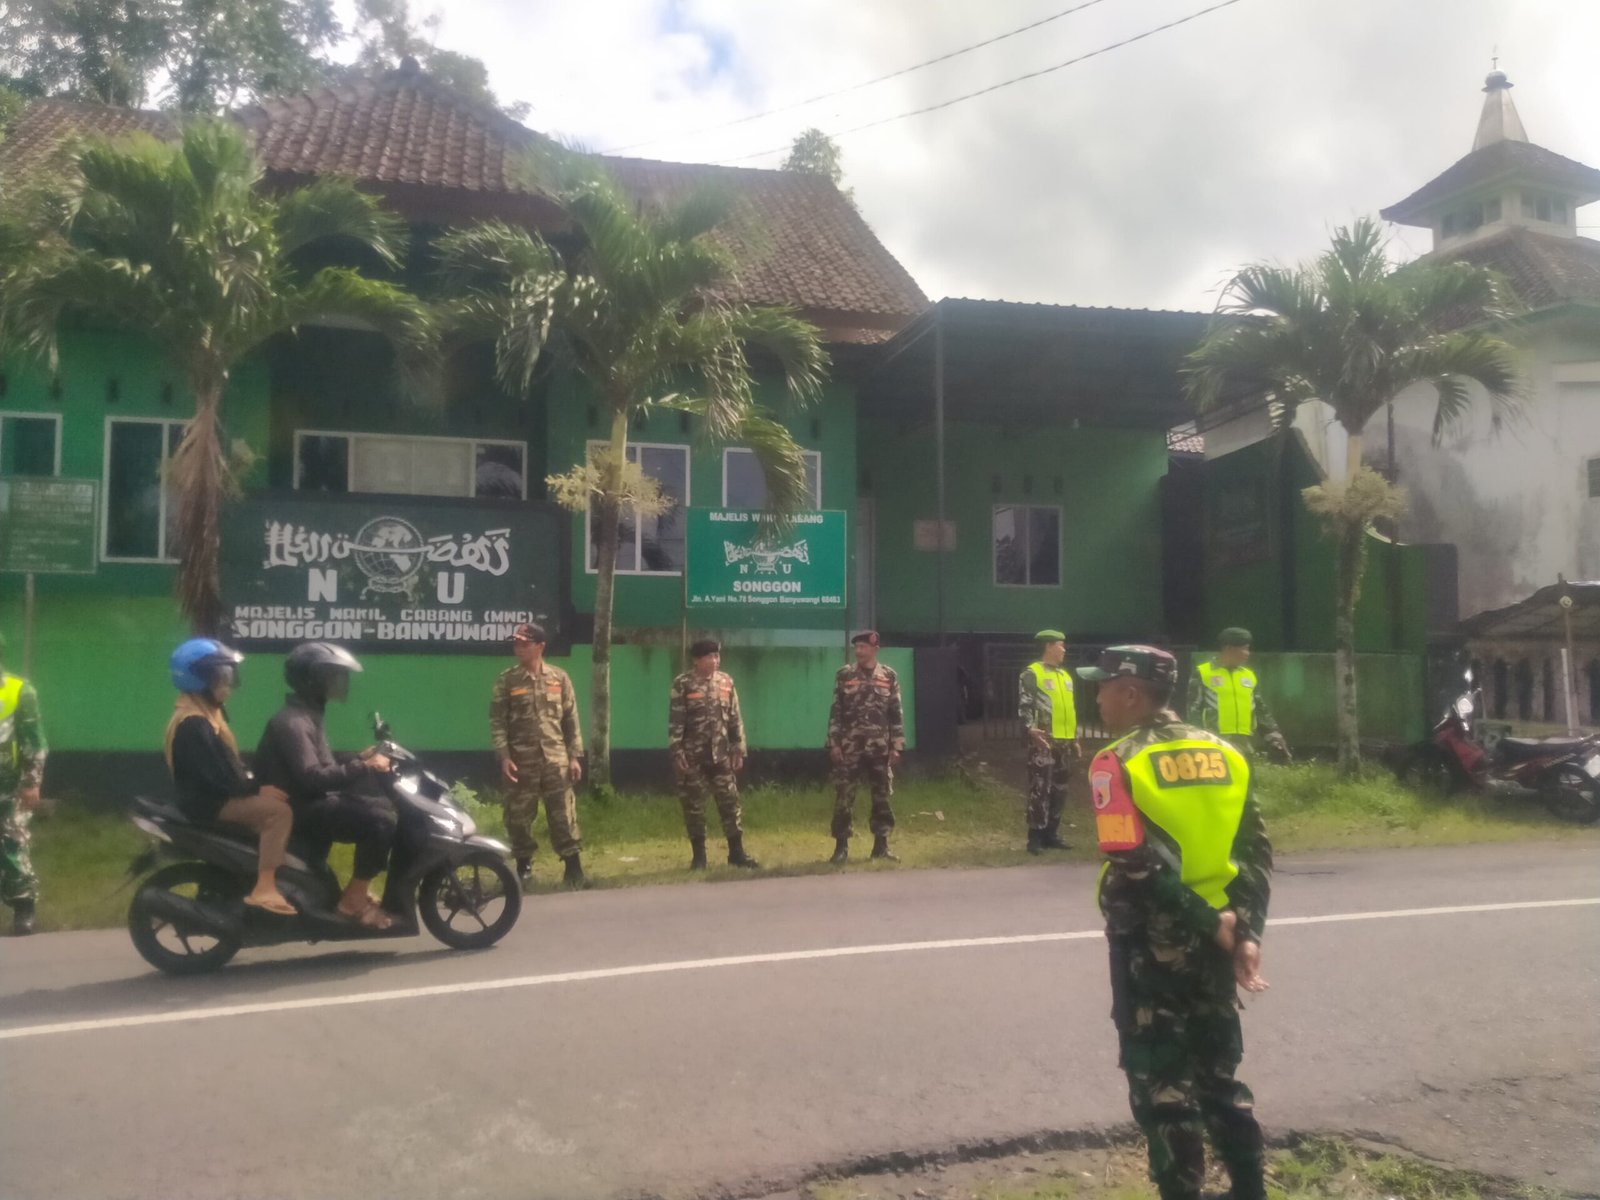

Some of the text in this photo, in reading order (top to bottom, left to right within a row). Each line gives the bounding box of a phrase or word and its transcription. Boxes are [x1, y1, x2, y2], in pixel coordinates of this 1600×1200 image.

[709, 512, 748, 522] MAJELIS
[739, 564, 792, 574] N U
[308, 568, 465, 604] N U
[733, 581, 801, 592] SONGGON
[235, 606, 534, 623] MAJELIS WAKIL CABANG (MWC)
[1158, 752, 1227, 783] 0825
